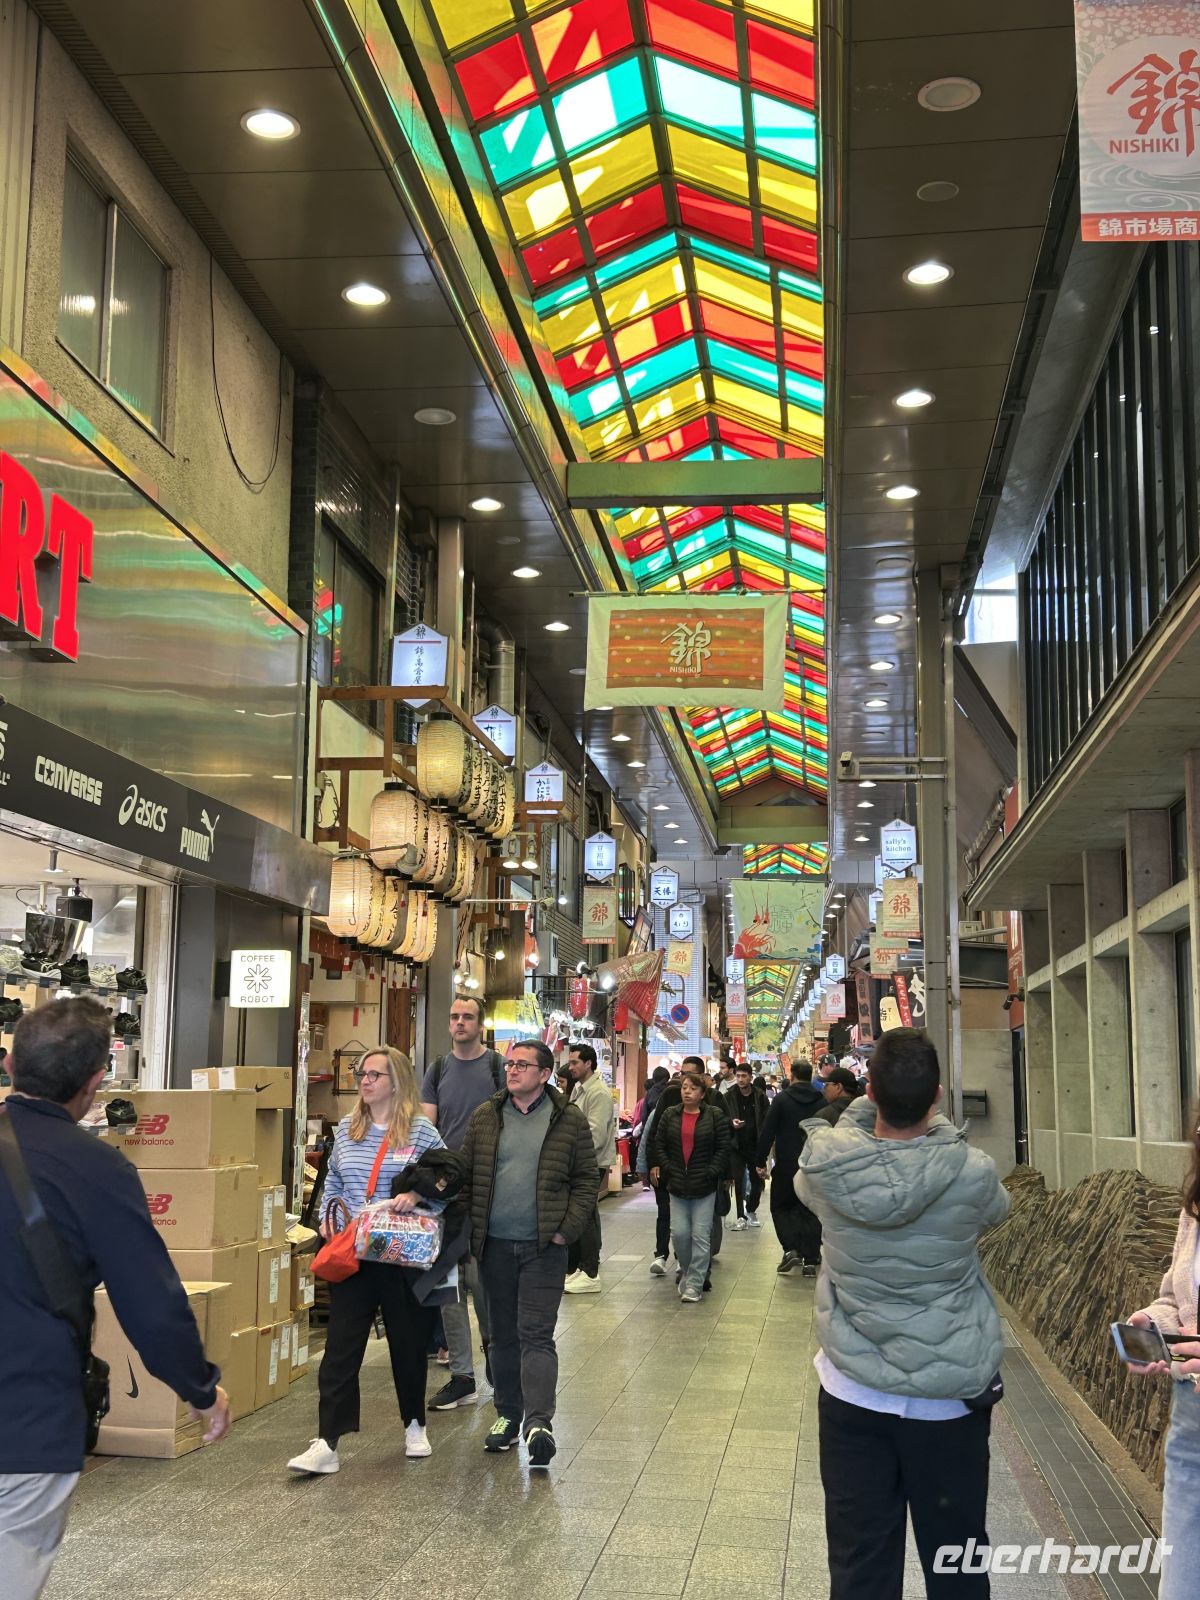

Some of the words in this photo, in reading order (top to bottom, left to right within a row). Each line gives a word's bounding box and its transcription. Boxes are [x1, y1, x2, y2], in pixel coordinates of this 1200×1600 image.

[1106, 49, 1200, 158] 錦
[1109, 138, 1180, 154] NISHIKI
[1098, 217, 1198, 237] 錦市場商
[660, 621, 712, 674] 錦
[670, 666, 698, 674] NISHIKI
[34, 755, 103, 806] CONVERSE
[134, 797, 168, 833] asics
[180, 827, 210, 862] PUMA
[885, 838, 907, 846] sally's
[589, 902, 608, 926] 錦
[888, 894, 911, 919] 錦
[240, 955, 276, 963] COFFEE
[240, 995, 275, 1003] ROBOT
[124, 1138, 141, 1146] new
[141, 1137, 175, 1146] balance
